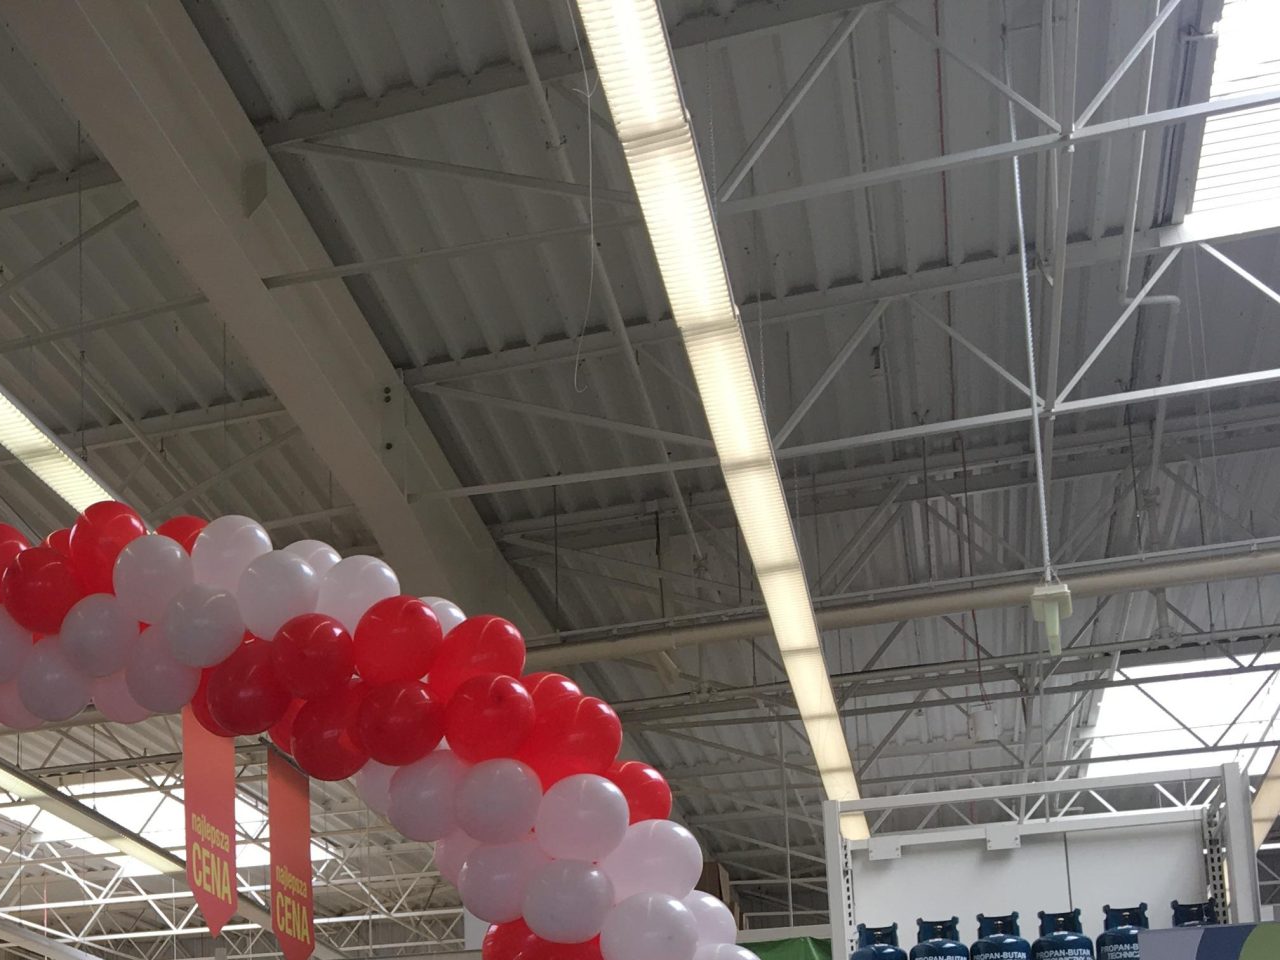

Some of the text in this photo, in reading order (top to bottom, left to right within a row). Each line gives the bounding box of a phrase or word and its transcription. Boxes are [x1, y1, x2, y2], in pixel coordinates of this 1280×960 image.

[192, 813, 229, 853] najlepsza
[192, 842, 232, 904] CENA
[276, 865, 307, 898] najlepsza
[276, 891, 310, 944] CENA
